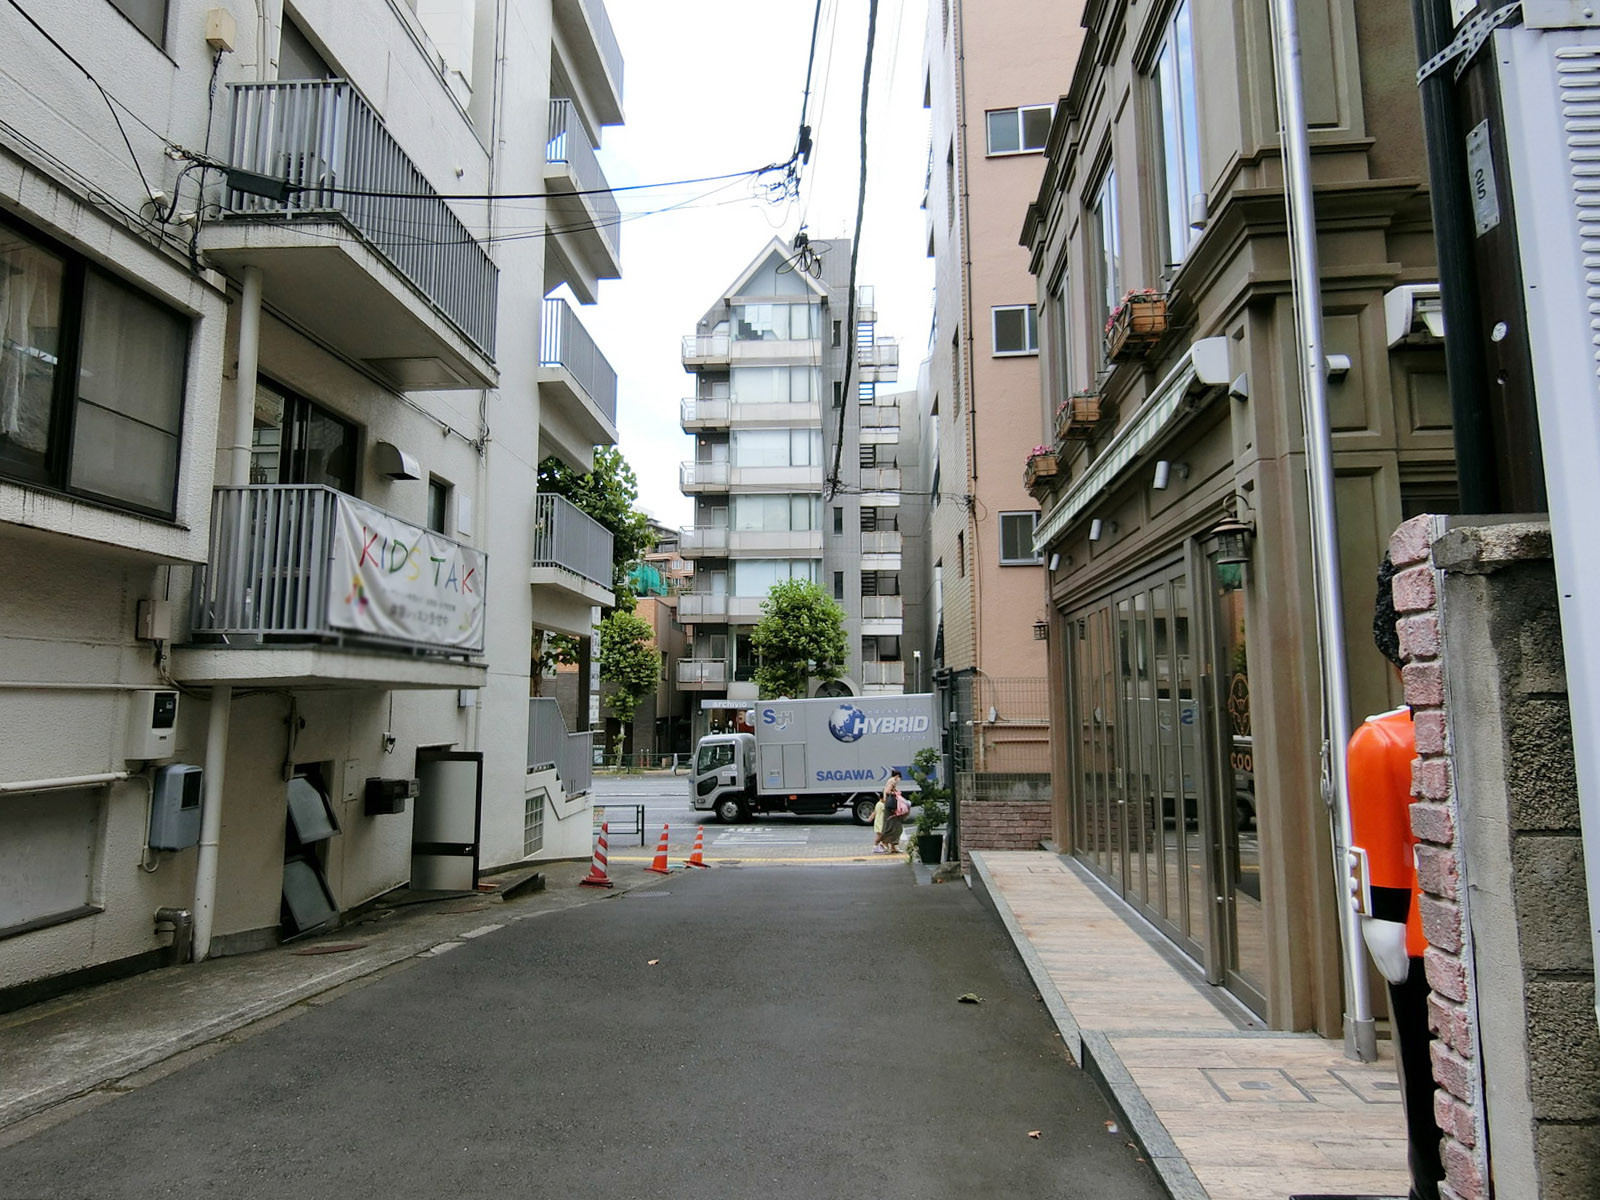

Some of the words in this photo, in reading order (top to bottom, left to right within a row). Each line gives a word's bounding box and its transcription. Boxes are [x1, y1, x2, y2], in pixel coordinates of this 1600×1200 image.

[1474, 168, 1487, 200] 25
[359, 526, 421, 581] KIDS
[430, 557, 475, 595] TAK
[712, 701, 747, 709] archivio
[853, 716, 929, 735] HYBRID
[816, 769, 875, 781] SAGAWA
